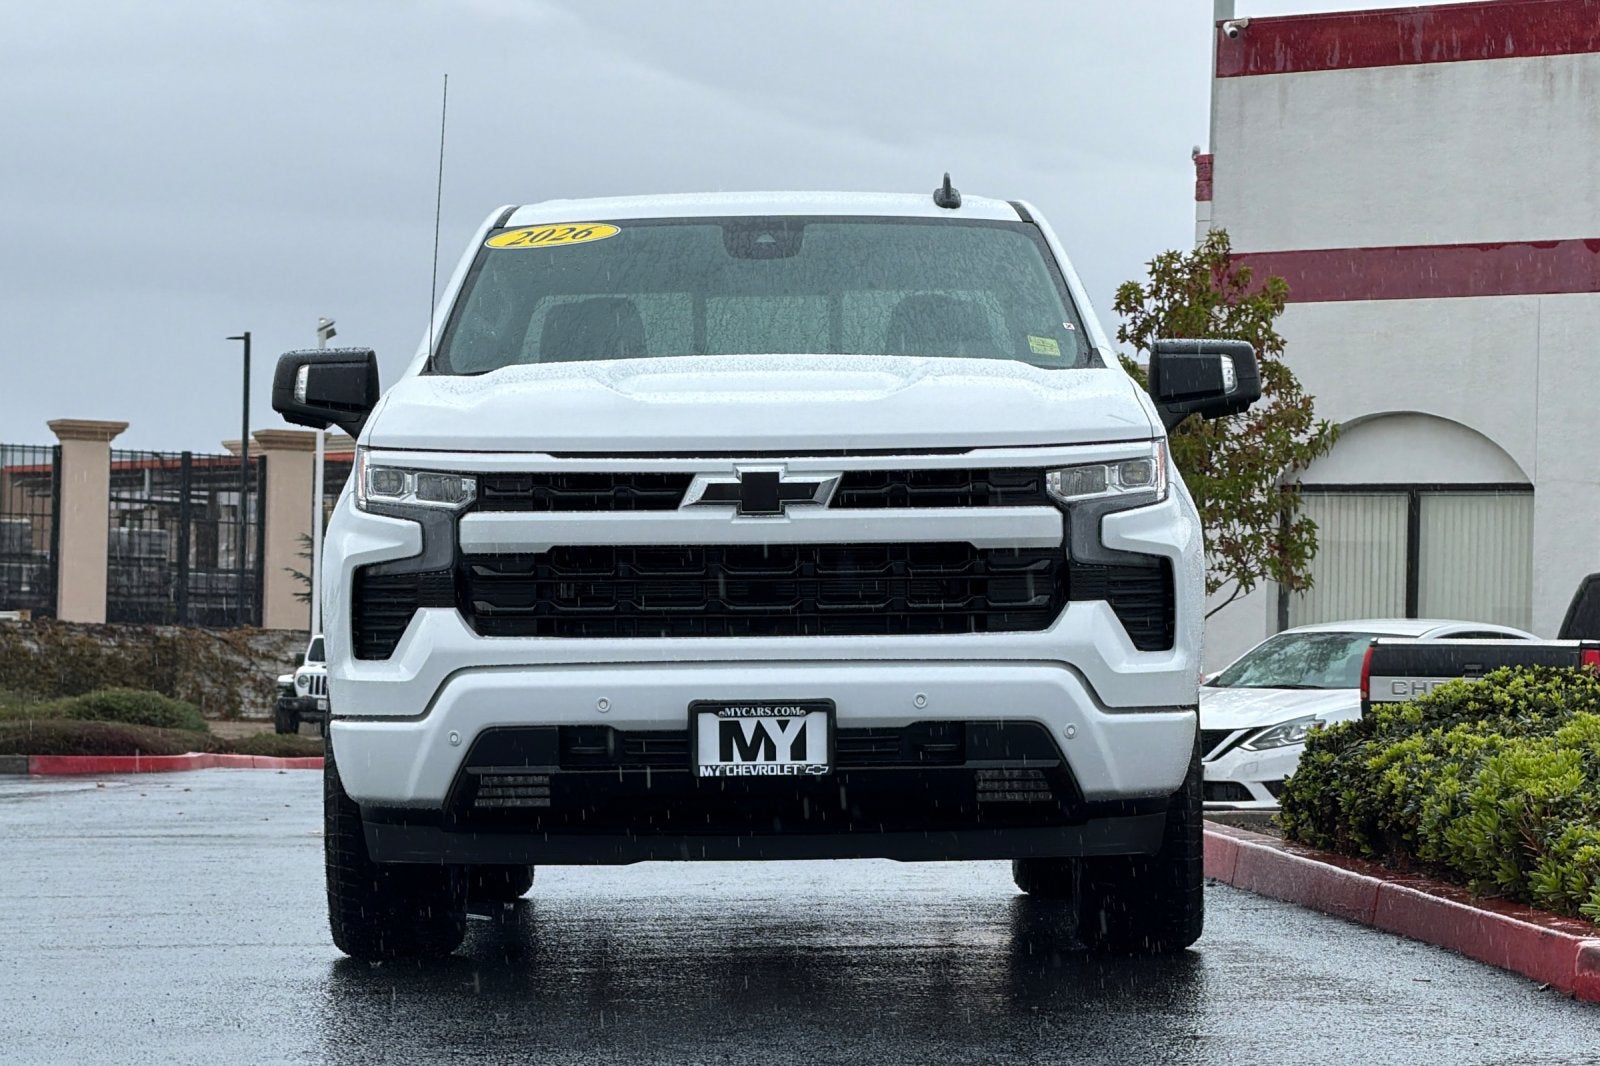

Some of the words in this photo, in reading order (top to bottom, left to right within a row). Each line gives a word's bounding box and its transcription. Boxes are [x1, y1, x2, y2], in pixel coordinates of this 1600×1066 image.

[506, 227, 598, 246] 2026
[724, 706, 800, 716] MYCARS.COM
[719, 720, 807, 762] MY
[700, 765, 719, 777] MY
[726, 764, 799, 776] CHEVROLET
